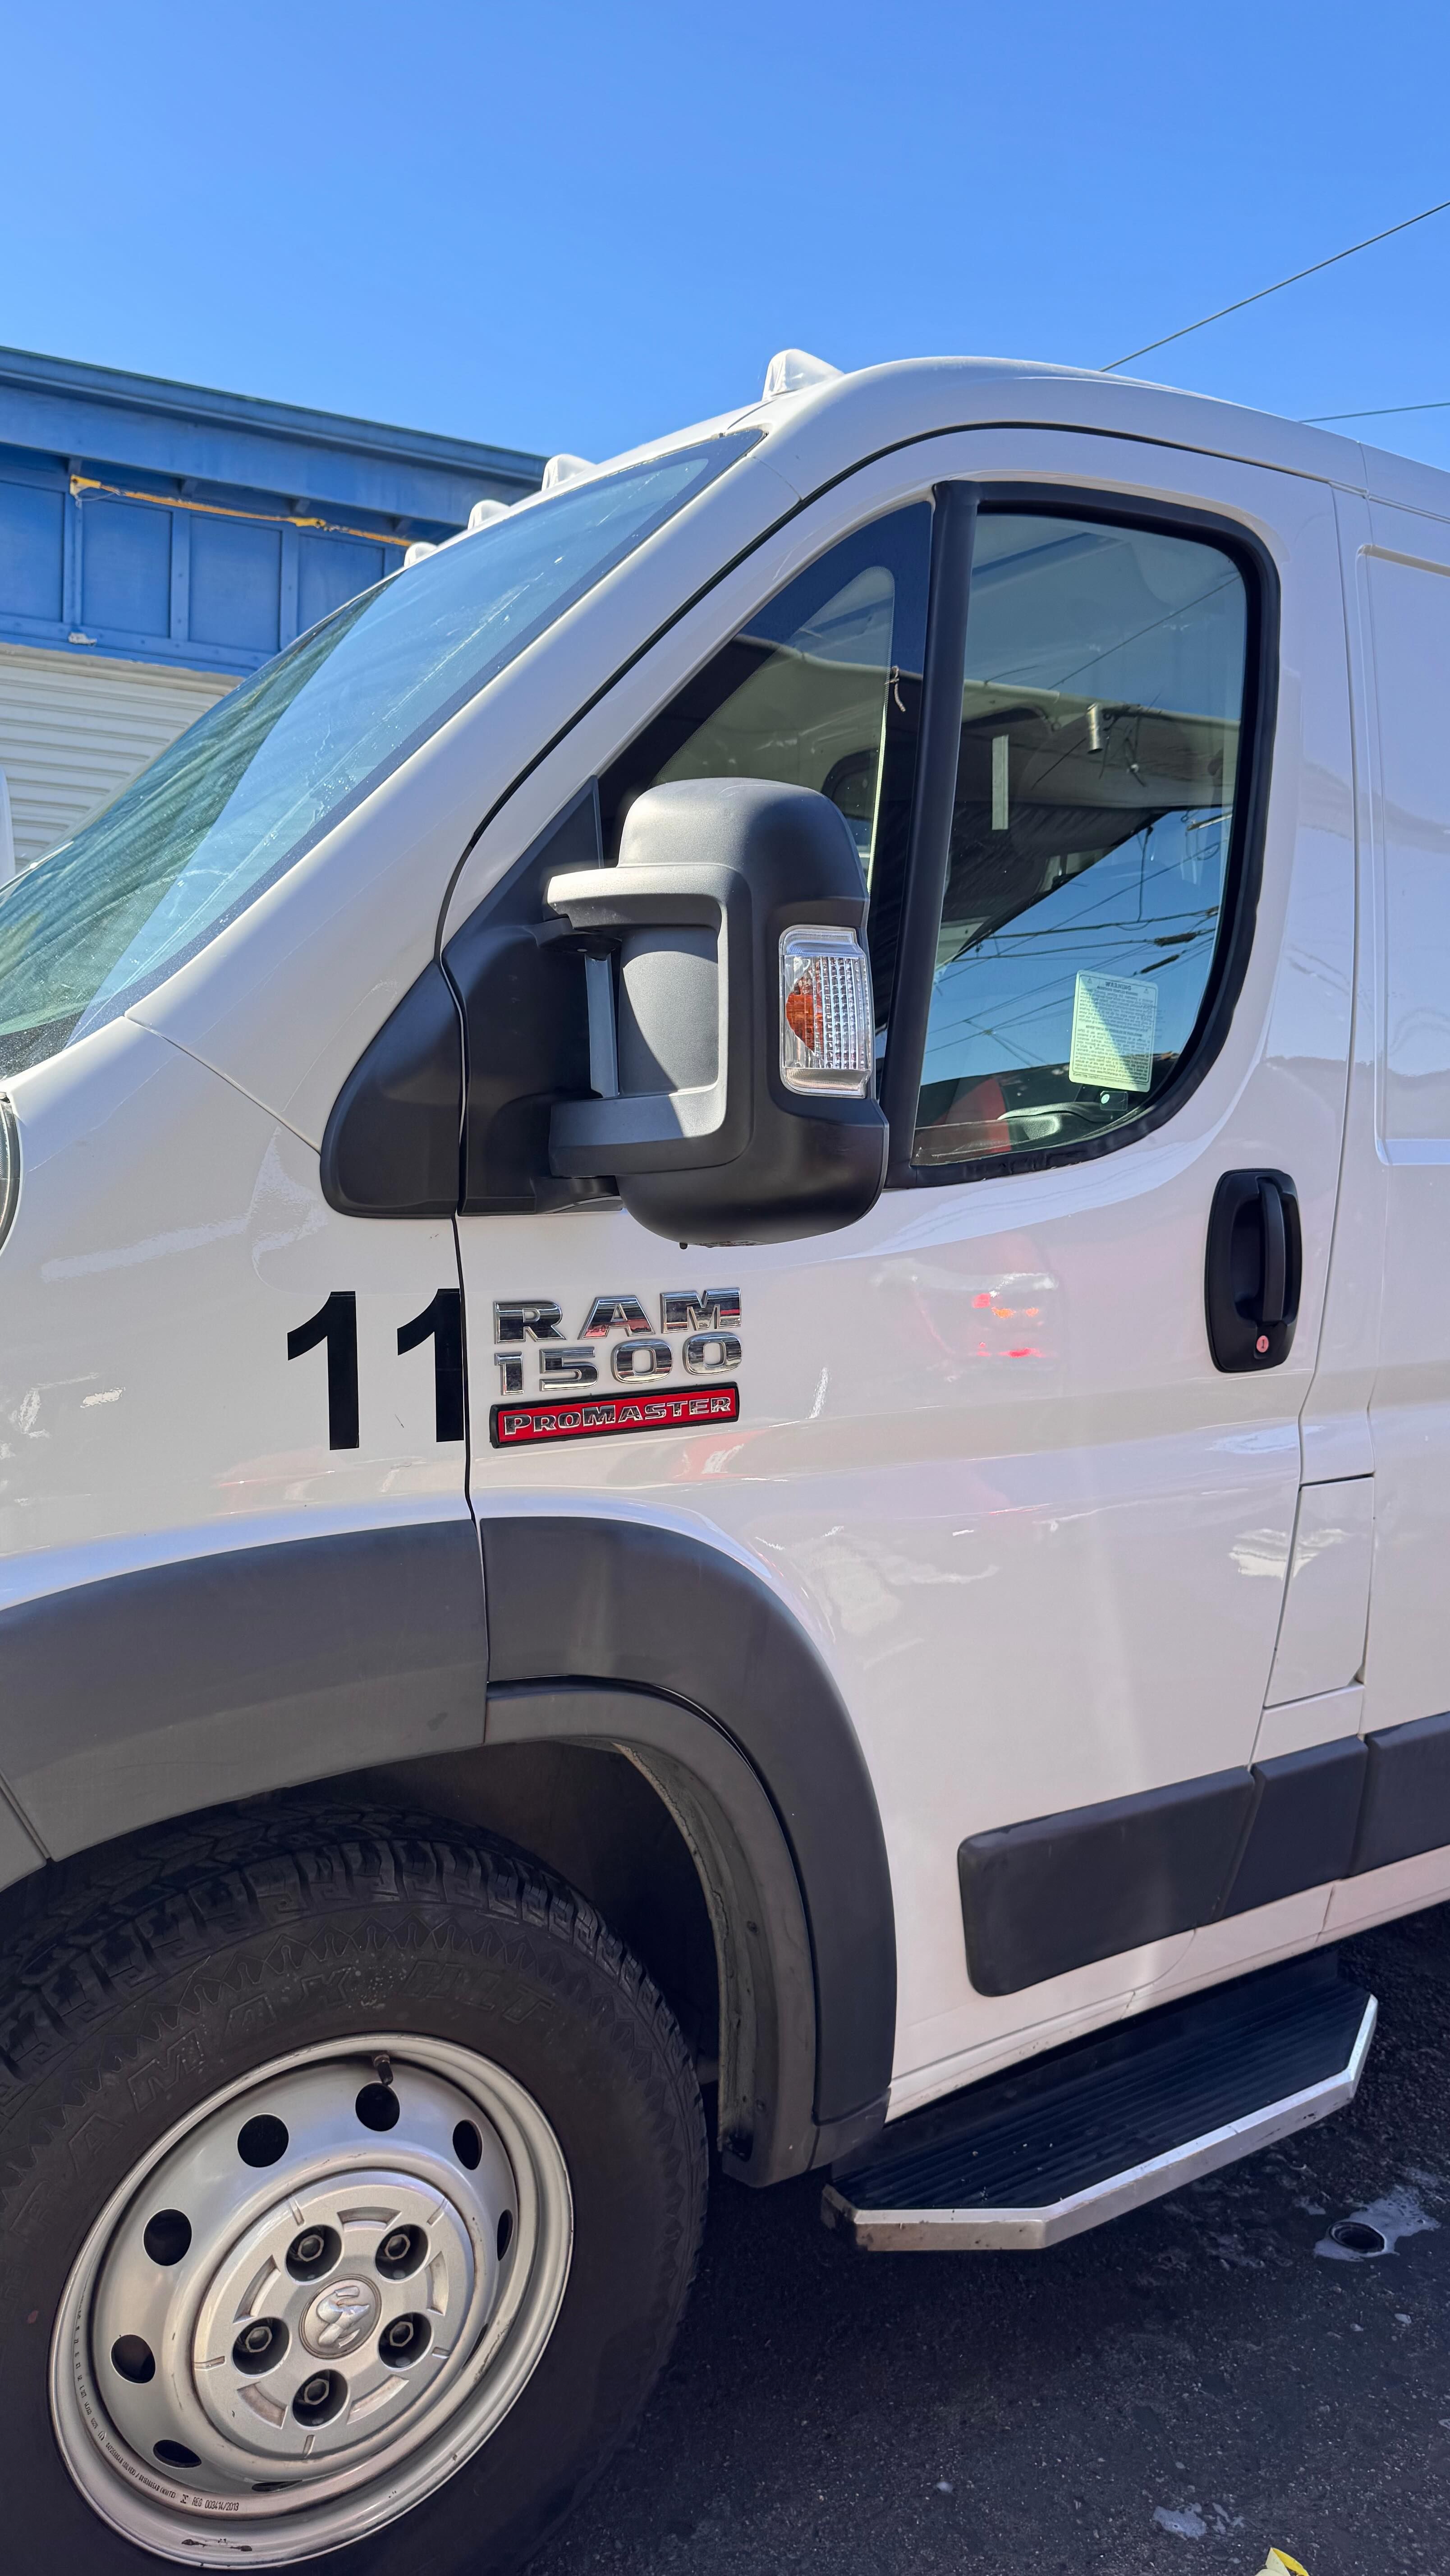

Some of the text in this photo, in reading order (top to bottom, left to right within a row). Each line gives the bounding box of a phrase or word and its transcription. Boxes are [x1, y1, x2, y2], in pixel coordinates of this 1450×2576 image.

[1105, 981, 1131, 991] WARNING
[494, 1288, 742, 1344] RAM
[287, 1288, 464, 1451] 11
[494, 1331, 743, 1396] 1500
[504, 1396, 732, 1436] PROMASTER
[192, 2496, 239, 2512] REG 003414/2013
